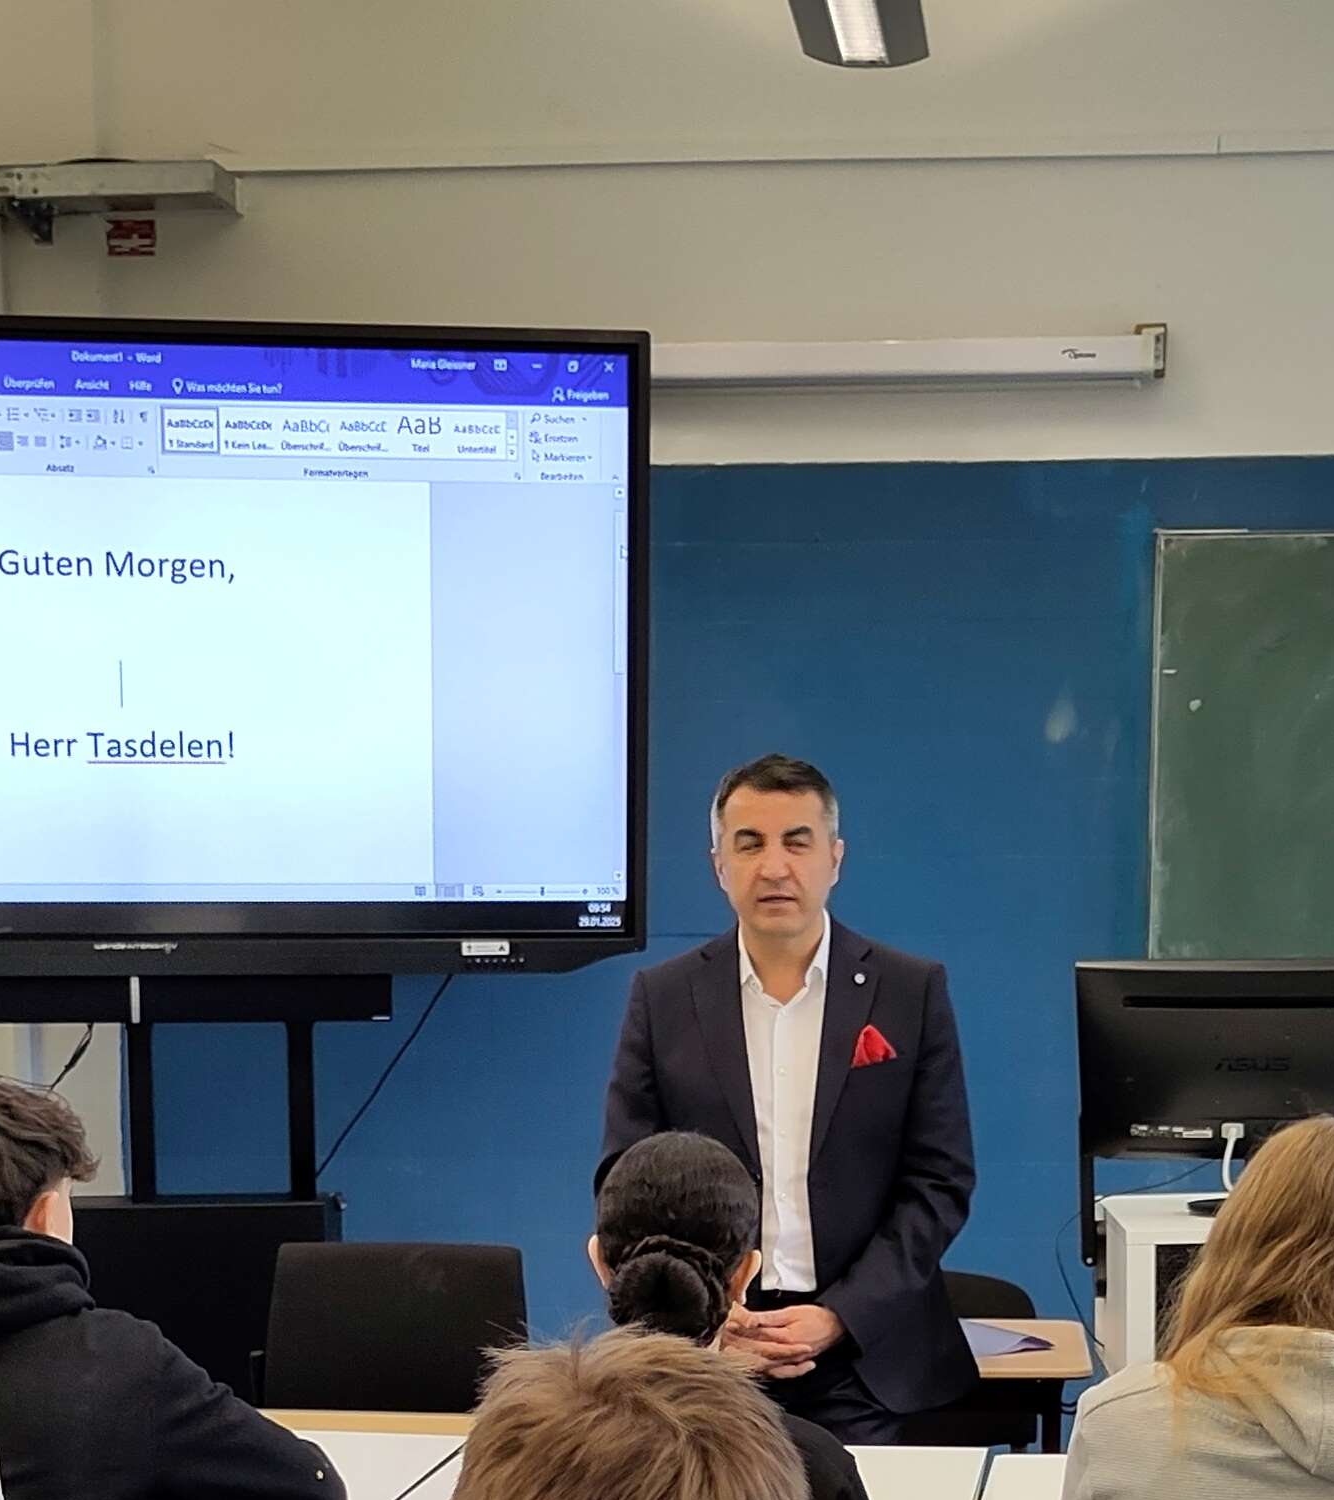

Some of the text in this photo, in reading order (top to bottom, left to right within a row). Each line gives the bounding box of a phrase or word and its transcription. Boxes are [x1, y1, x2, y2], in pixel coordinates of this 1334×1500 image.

[71, 351, 123, 363] Dokument1
[135, 353, 162, 364] Word
[410, 357, 436, 369] Maria
[3, 375, 55, 390] Überprüfen
[74, 378, 110, 391] Ansicht
[129, 380, 152, 392] Hilfe
[185, 380, 283, 394] Was möchten Sie tun?
[567, 390, 609, 402] Freigeben
[544, 414, 575, 424] Suchen
[176, 439, 214, 449] Standard
[231, 440, 250, 449] Kein
[411, 443, 429, 453] Titel
[457, 445, 497, 454] Untertitel
[544, 452, 586, 462] Markieren
[46, 463, 75, 473] Absatz
[303, 467, 369, 478] Formatvorlagen
[540, 472, 584, 481] Bearbeiten
[105, 550, 235, 584] Morgen,
[10, 730, 235, 759] Herr Tasdelen!
[1213, 1056, 1291, 1072] ASUS
